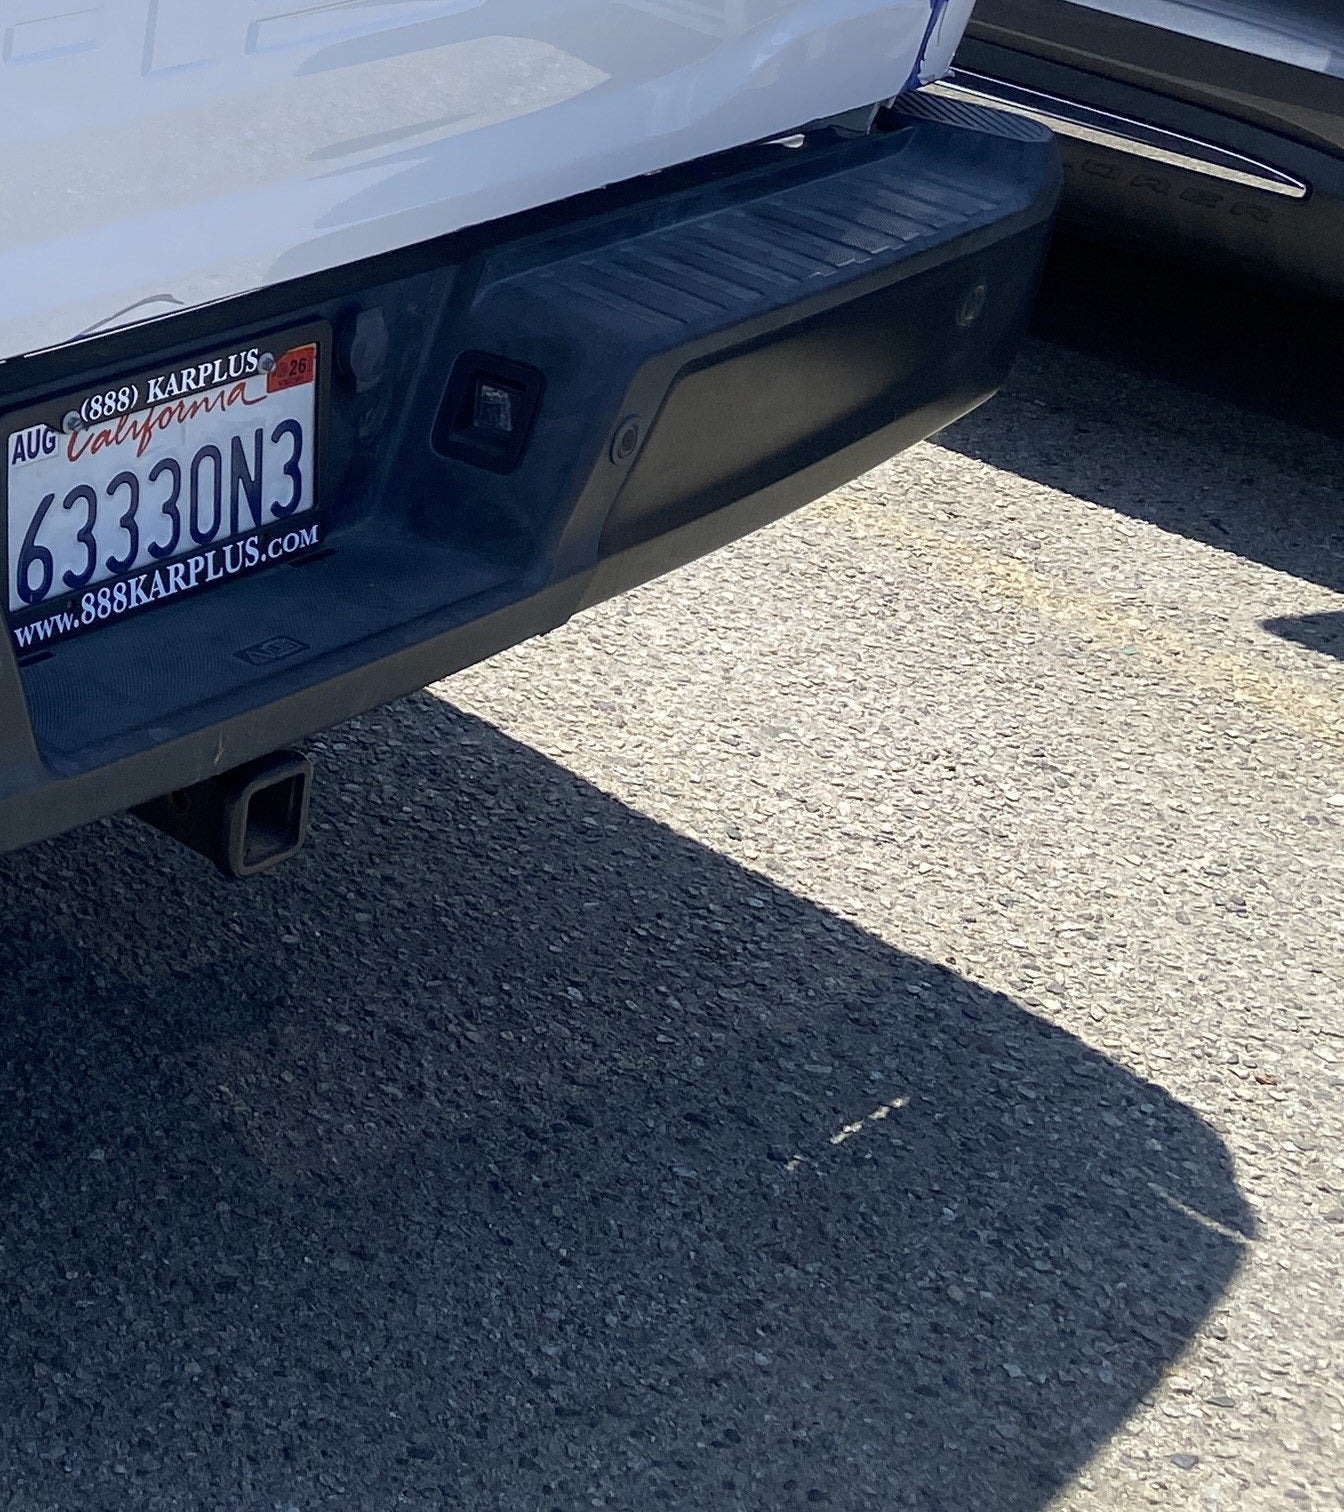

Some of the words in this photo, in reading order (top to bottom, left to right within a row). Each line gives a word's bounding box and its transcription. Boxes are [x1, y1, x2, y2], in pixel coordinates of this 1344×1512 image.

[81, 385, 139, 423] (888)
[146, 348, 259, 405] KARPLUS
[288, 357, 307, 377] 26
[12, 429, 57, 465] AUG
[66, 377, 267, 462] California
